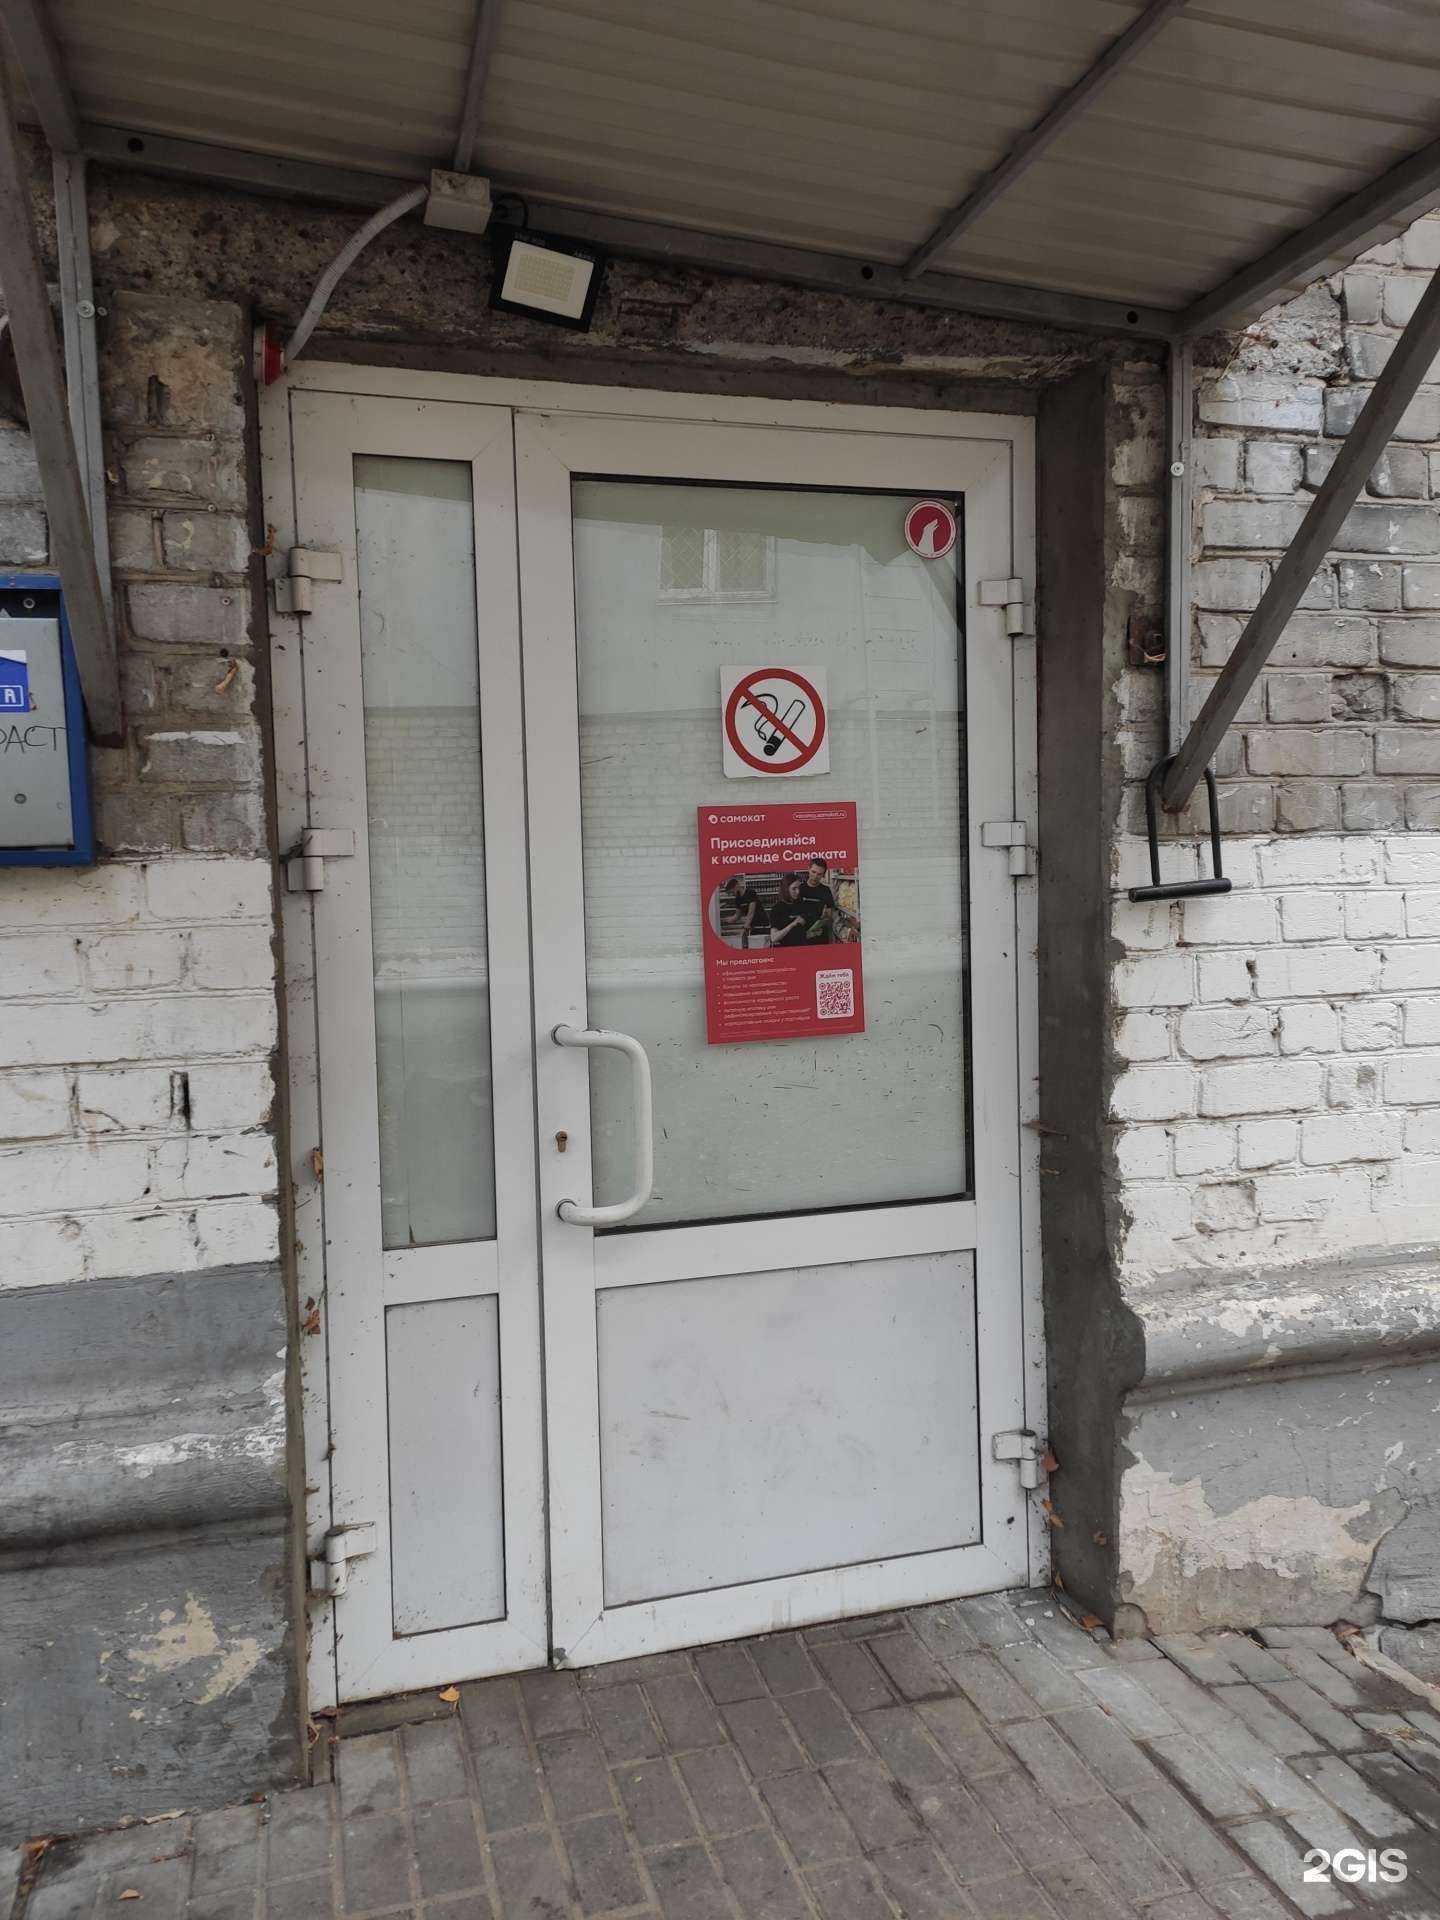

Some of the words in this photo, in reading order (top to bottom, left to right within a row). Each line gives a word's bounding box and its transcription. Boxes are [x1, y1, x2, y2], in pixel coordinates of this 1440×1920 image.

[720, 814, 767, 824] самокат
[711, 834, 816, 851] Присоединяйся
[711, 856, 719, 865] к
[722, 853, 780, 866] команде
[782, 849, 847, 862] Самоката
